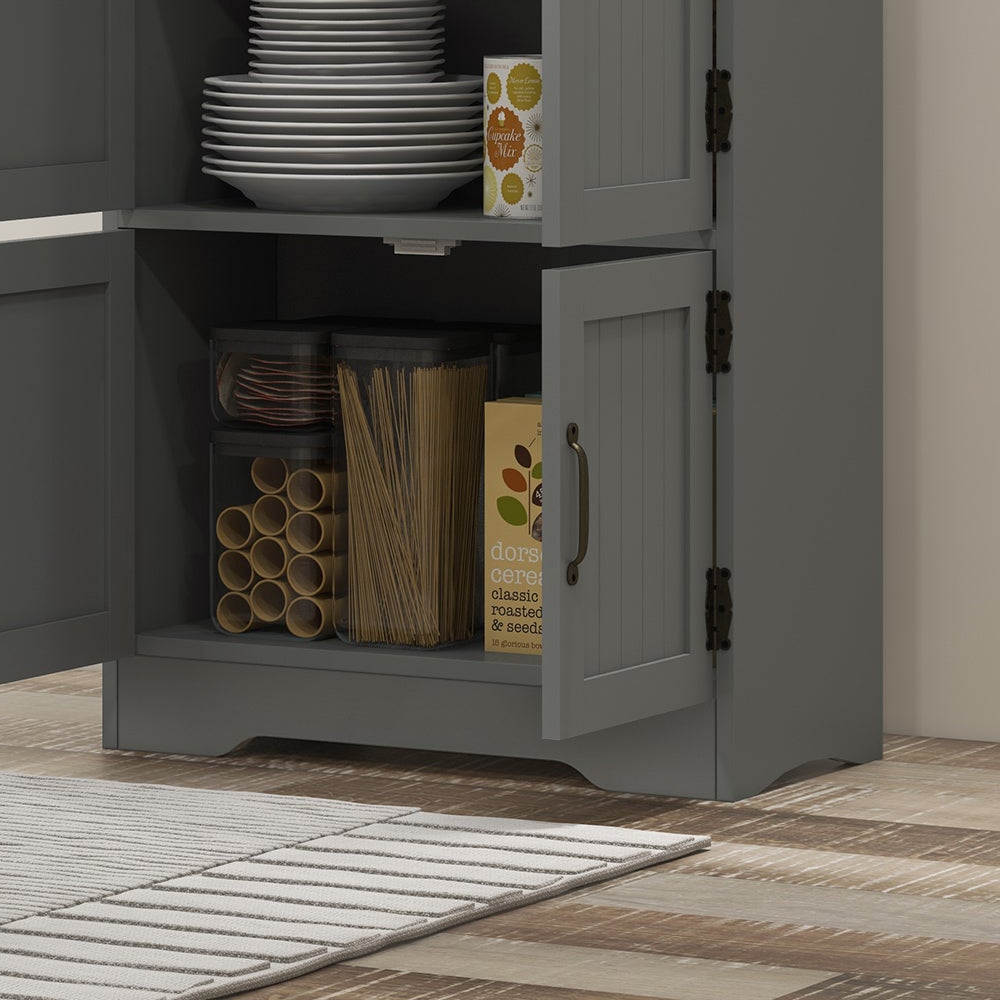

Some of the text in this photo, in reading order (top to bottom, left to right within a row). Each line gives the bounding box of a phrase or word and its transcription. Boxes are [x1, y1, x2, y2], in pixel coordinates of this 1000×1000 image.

[488, 126, 521, 142] Cupcake
[494, 142, 517, 159] Mix
[491, 587, 539, 603] classic
[491, 605, 542, 619] roasted
[491, 619, 503, 632] &
